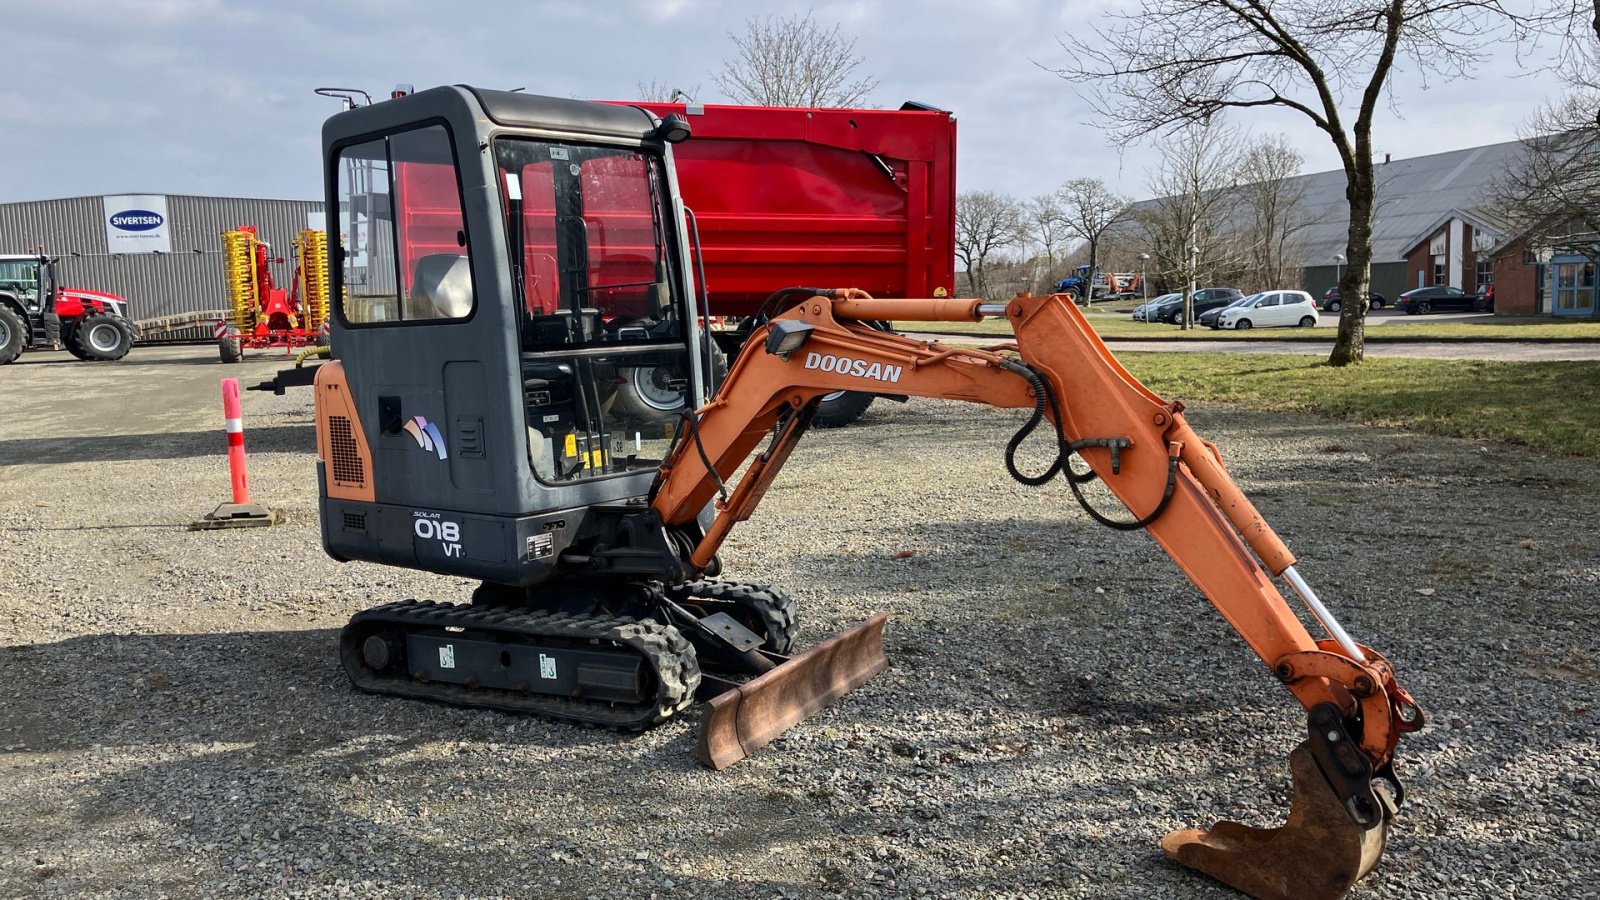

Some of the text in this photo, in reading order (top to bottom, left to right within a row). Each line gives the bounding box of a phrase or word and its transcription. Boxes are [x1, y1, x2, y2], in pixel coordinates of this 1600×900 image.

[113, 216, 161, 225] SIVERTSEN
[804, 351, 902, 383] DOOSAN
[413, 511, 441, 519] SOLAR
[414, 518, 460, 542] 018
[442, 542, 462, 558] VT
